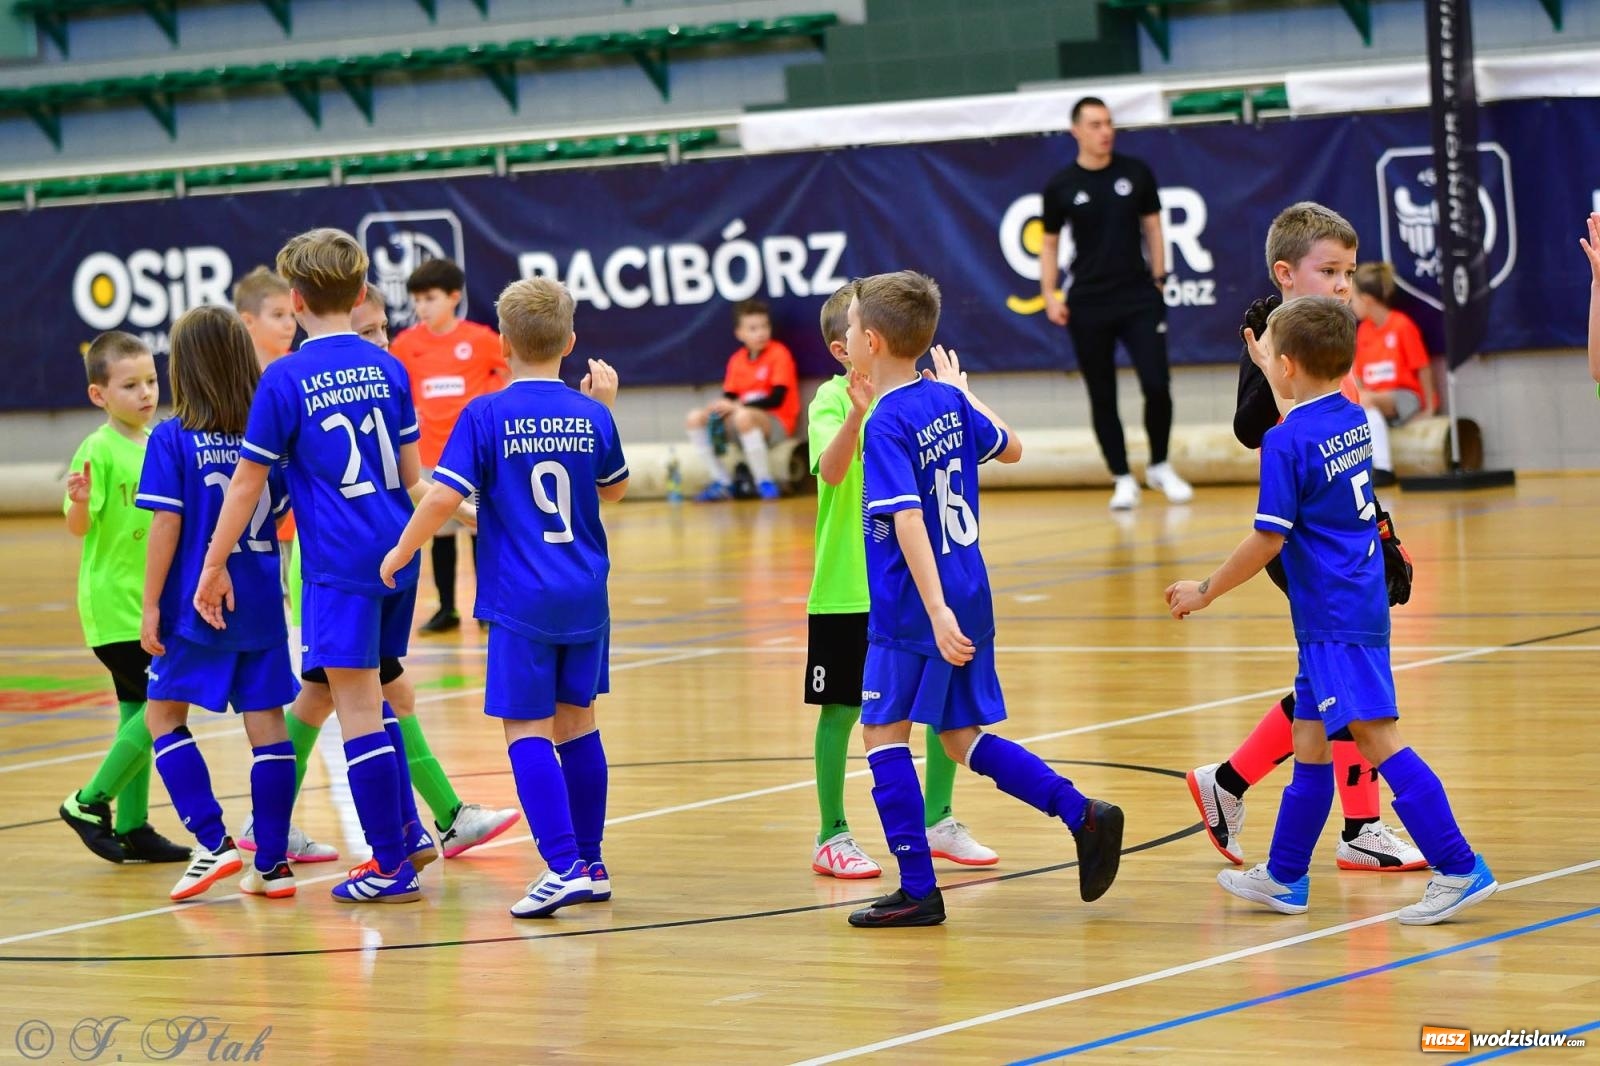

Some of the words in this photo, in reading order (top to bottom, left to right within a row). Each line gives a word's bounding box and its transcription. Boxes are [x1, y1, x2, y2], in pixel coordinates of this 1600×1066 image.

[1000, 186, 1214, 282] OR
[301, 371, 335, 394] LKS
[336, 366, 386, 386] ORZEŁ
[305, 383, 391, 417] JANKOWICE
[193, 431, 224, 448] LKS
[503, 418, 537, 436] LKS
[540, 417, 594, 434] ORZEŁ
[1318, 435, 1344, 458] LKS
[1344, 423, 1372, 447] ORZE
[196, 449, 240, 470] JANKO
[320, 407, 401, 499] 21
[503, 437, 595, 459] JANKOWICE
[530, 460, 574, 544] 9
[812, 665, 826, 693] 8
